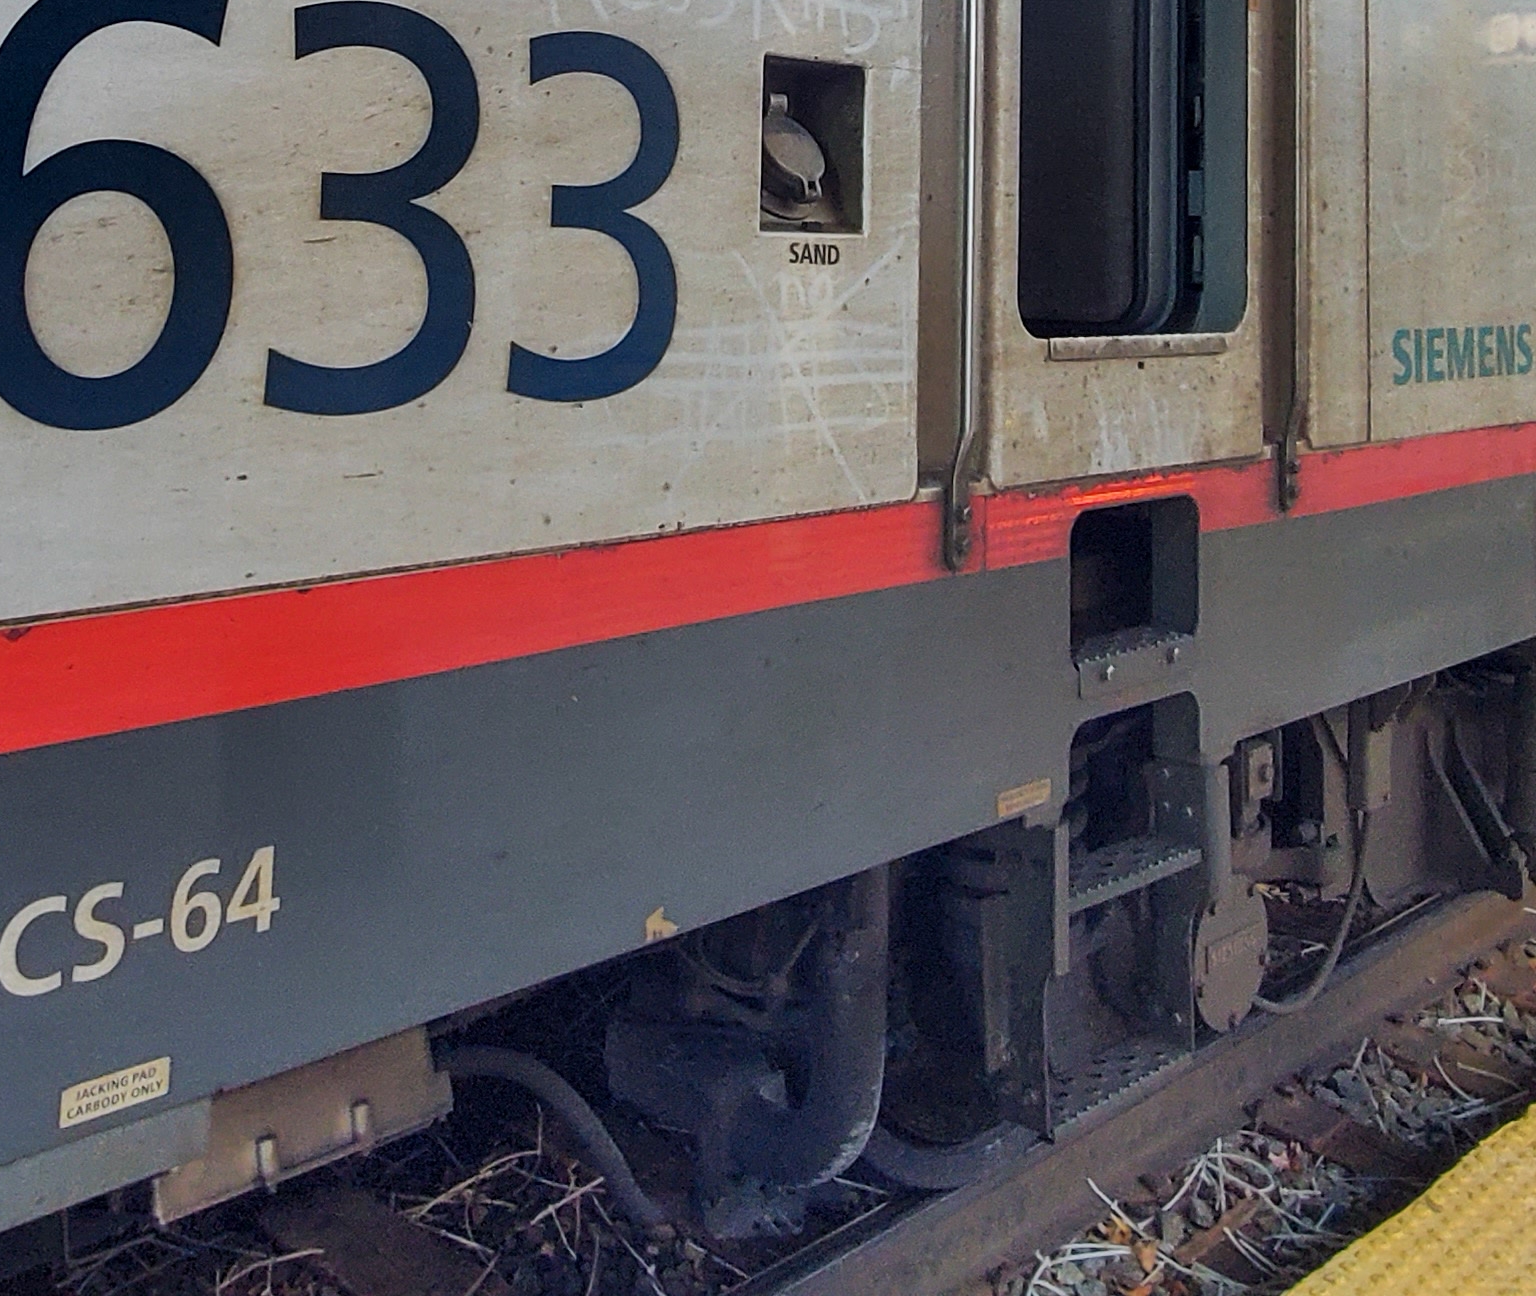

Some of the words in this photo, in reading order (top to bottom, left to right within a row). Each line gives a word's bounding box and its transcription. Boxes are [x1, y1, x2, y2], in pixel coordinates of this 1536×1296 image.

[789, 242, 841, 266] SAND
[1392, 323, 1533, 386] SIEMENS
[66, 1091, 128, 1120] CARBODY
[131, 1079, 164, 1098] ONLY
[76, 1075, 129, 1101] JACKING
[132, 1067, 157, 1084] PAD
